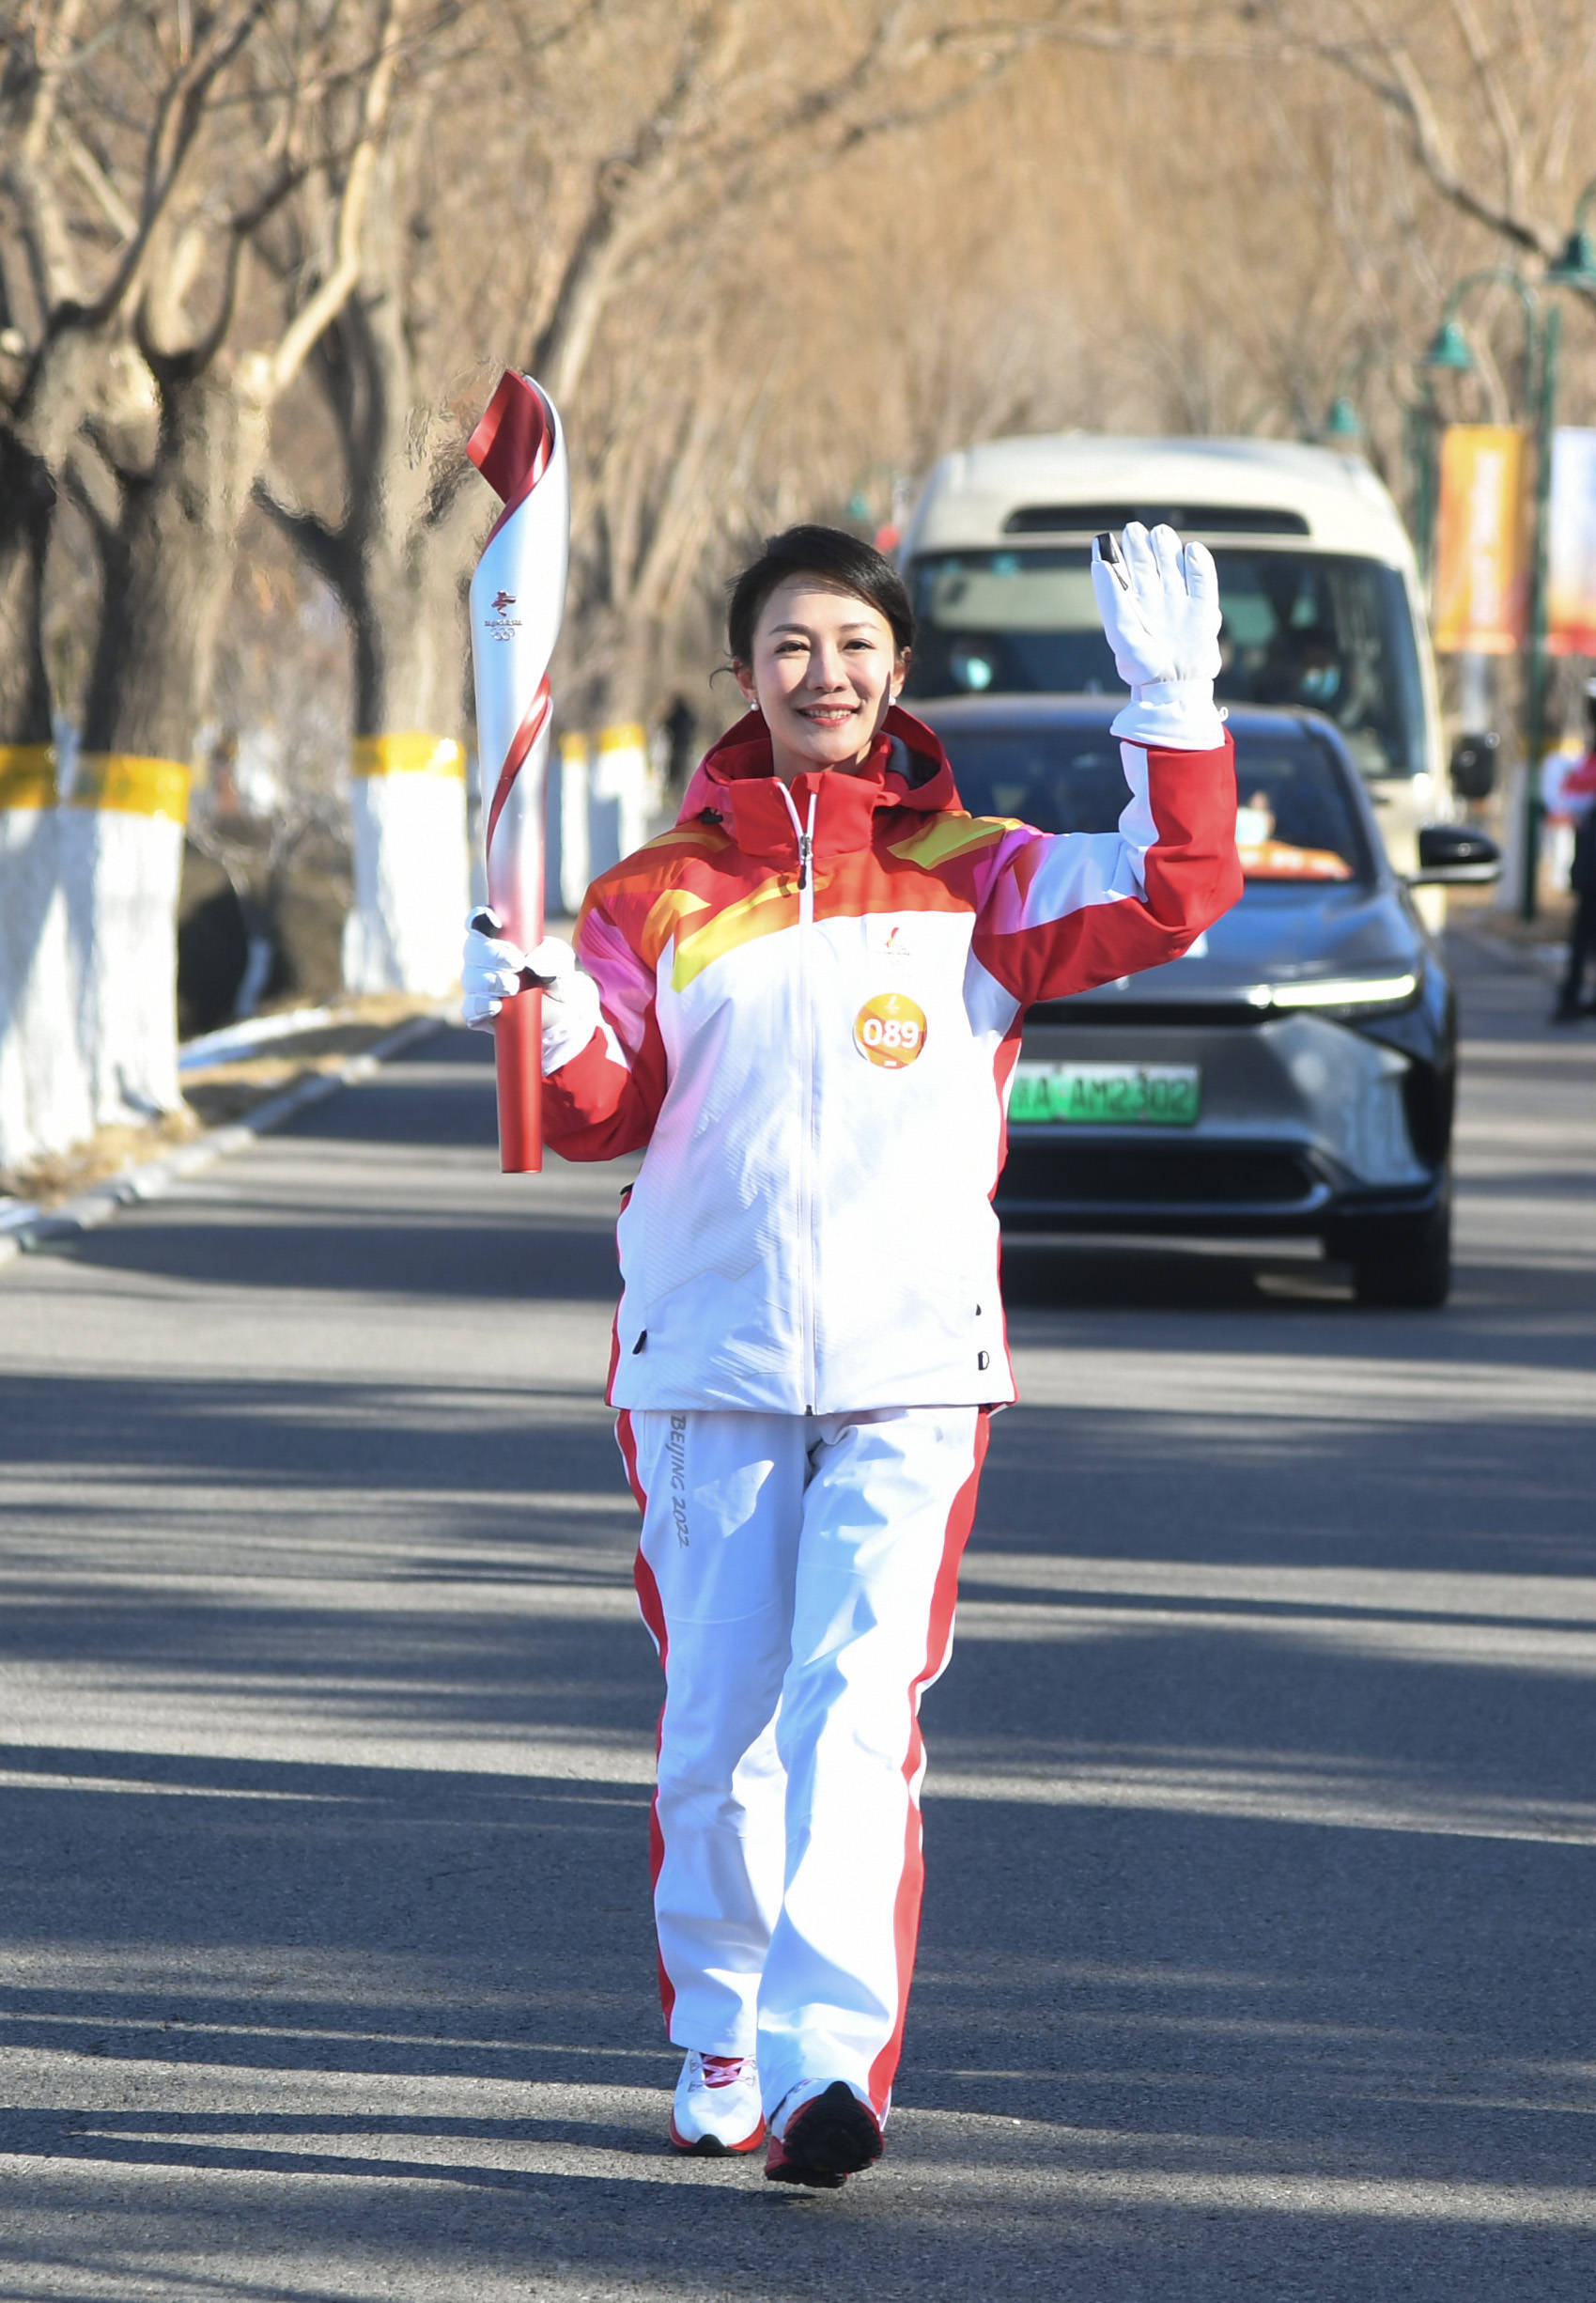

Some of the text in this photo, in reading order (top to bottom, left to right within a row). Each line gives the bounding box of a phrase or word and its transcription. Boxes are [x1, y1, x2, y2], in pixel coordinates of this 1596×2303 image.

[862, 1018, 920, 1050] 089
[664, 1414, 690, 1549] BEIJING 2022
